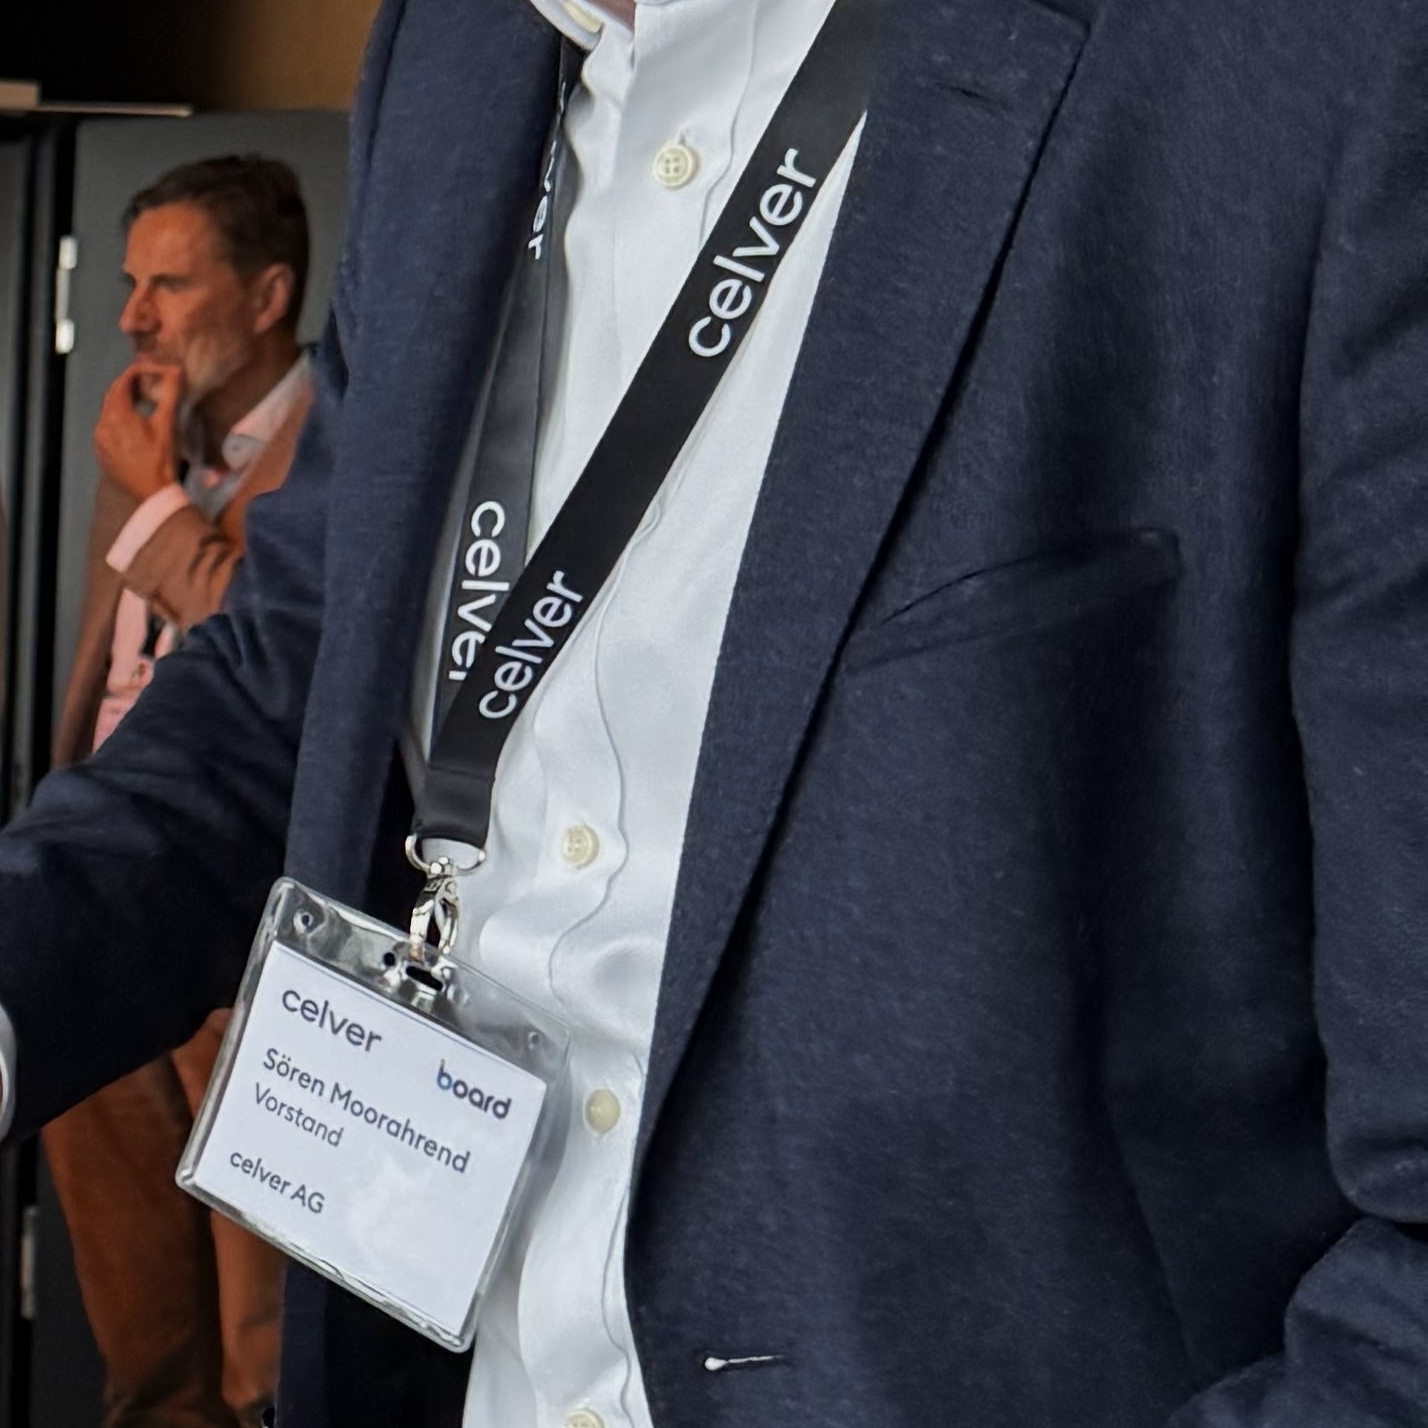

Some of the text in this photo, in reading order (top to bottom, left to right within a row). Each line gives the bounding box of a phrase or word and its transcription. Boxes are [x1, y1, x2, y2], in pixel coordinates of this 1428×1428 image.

[688, 147, 816, 357] celver
[478, 570, 583, 719] celver
[282, 989, 382, 1052] celver
[254, 1082, 344, 1147] Vorstand
[263, 1048, 471, 1174] Sören Moorahrend
[436, 1058, 512, 1119] board
[230, 1151, 325, 1214] celver AG
